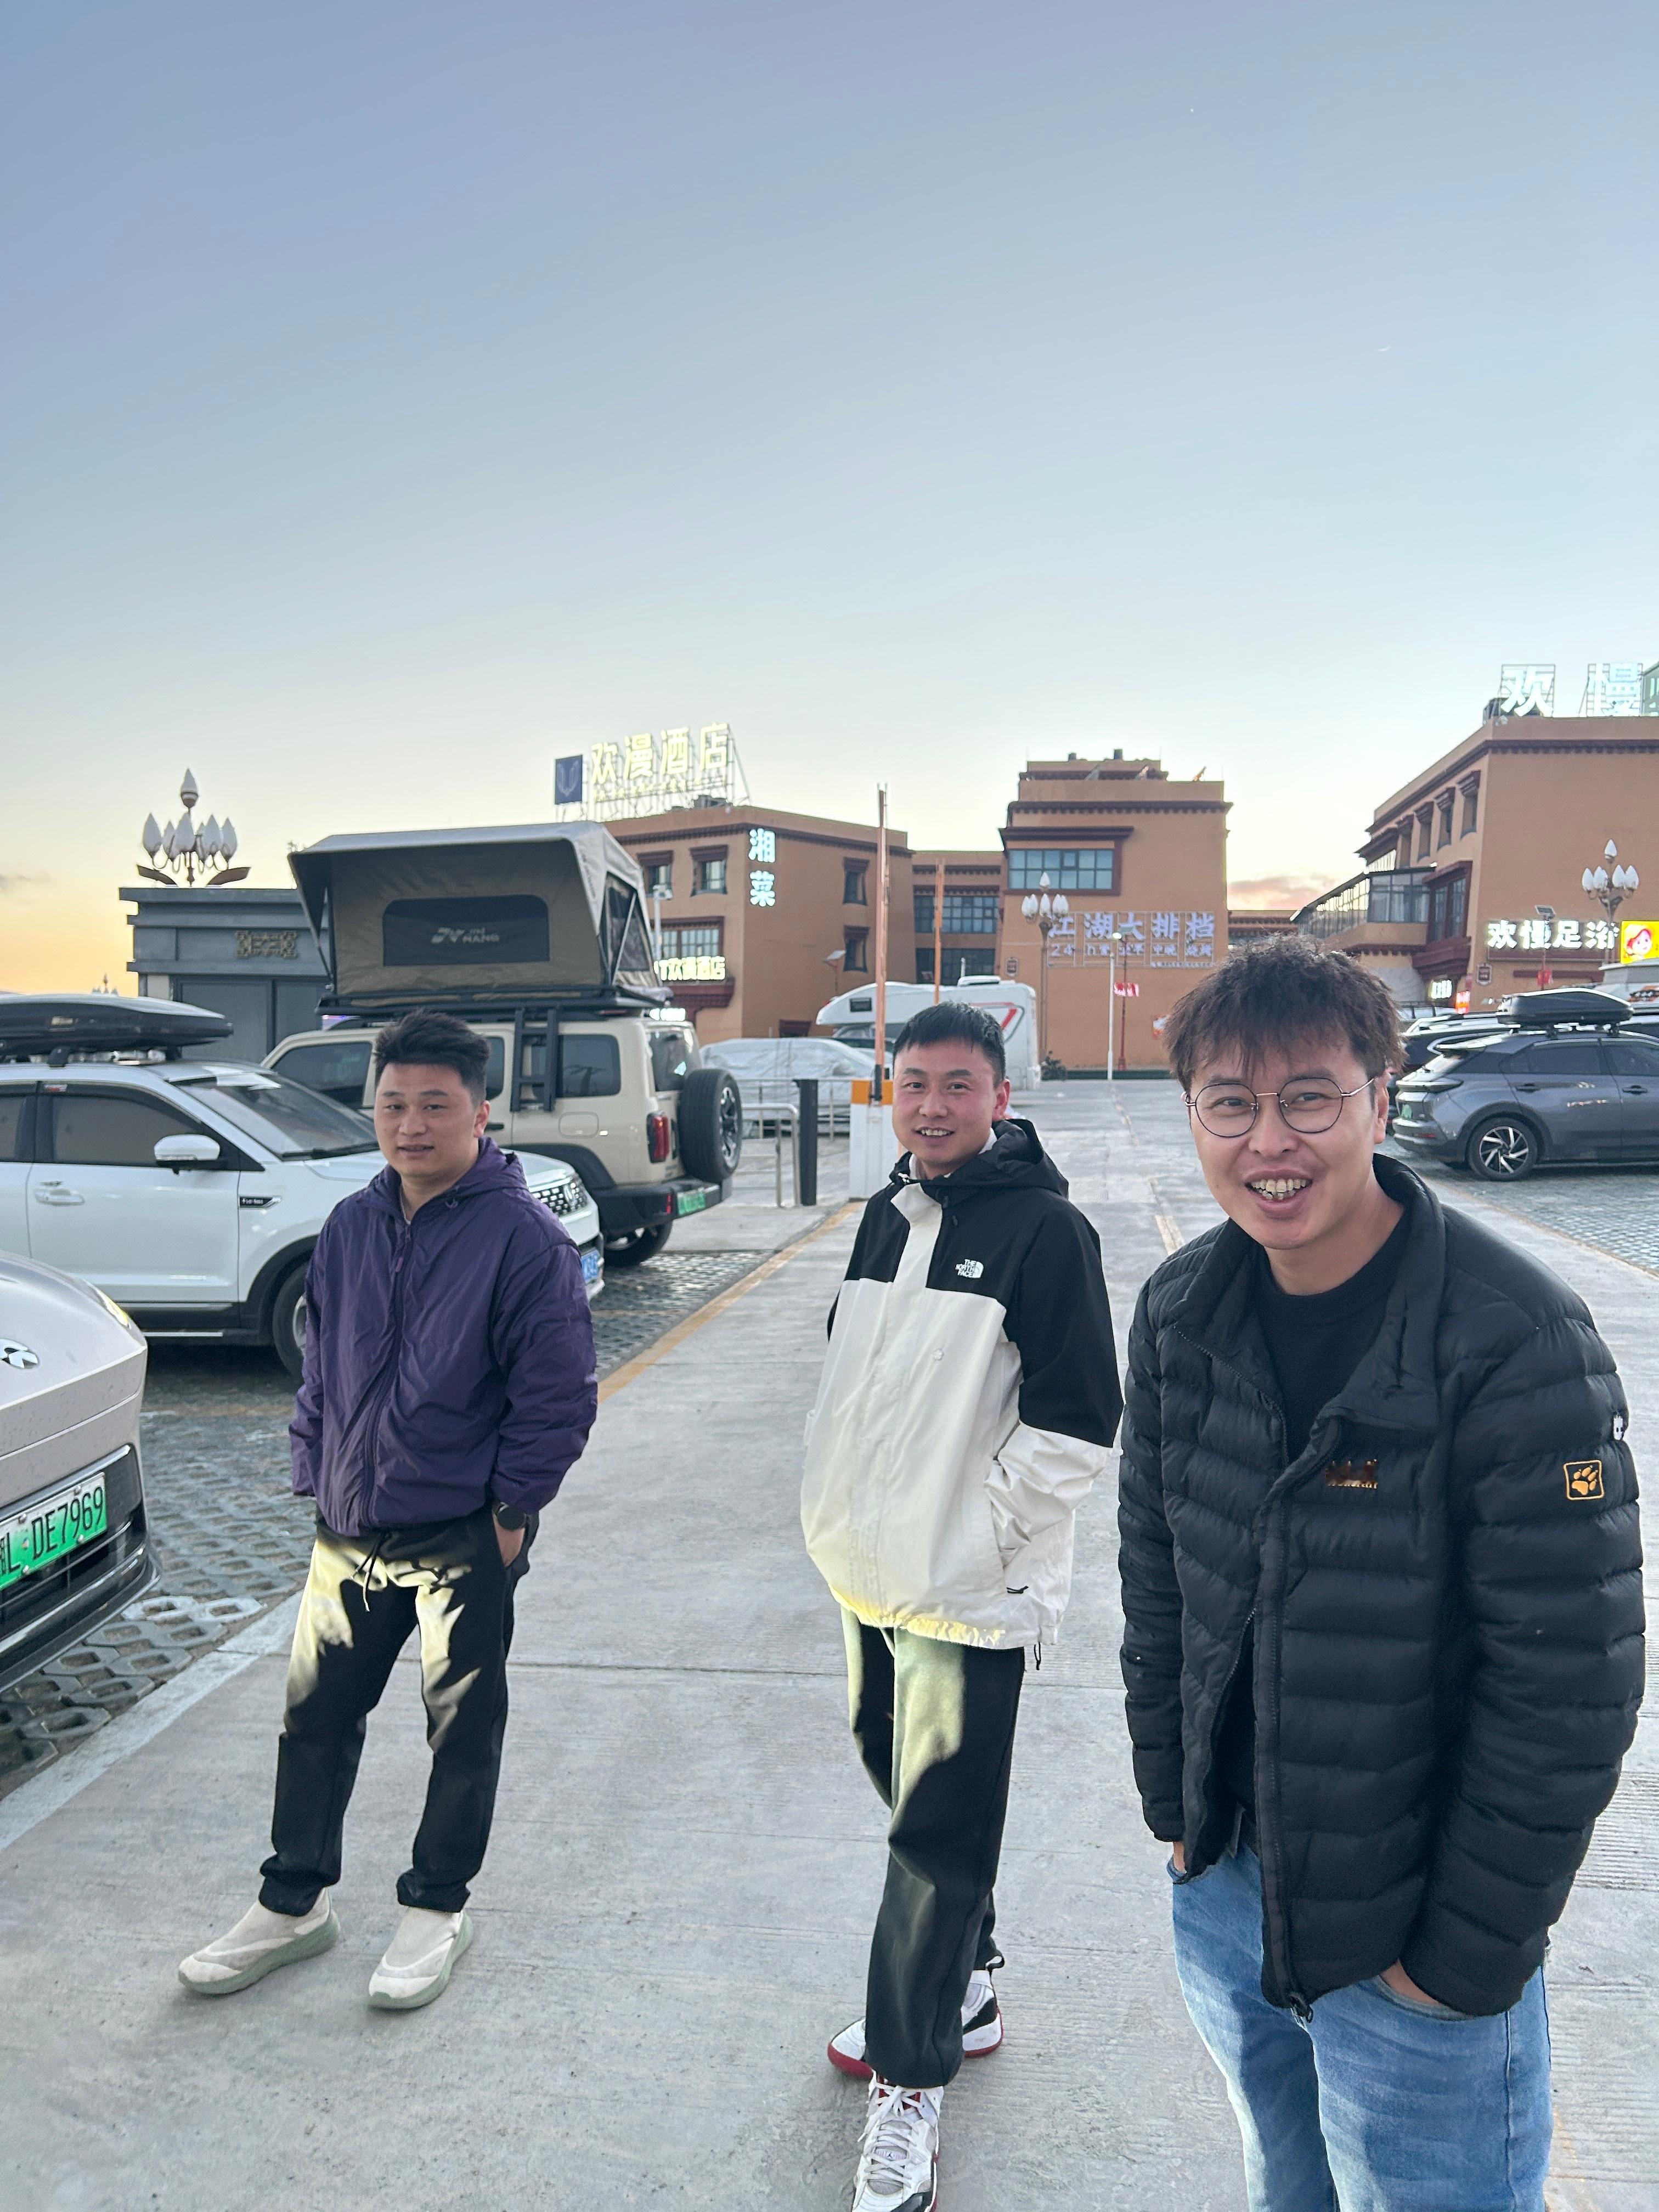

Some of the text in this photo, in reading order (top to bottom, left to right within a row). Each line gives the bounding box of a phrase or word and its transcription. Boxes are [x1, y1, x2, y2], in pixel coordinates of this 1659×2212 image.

[591, 722, 728, 785] 欢漫酒店
[748, 828, 776, 907] 湘菜
[1047, 911, 1214, 940] 江湖大排档
[31, 1486, 104, 1560] DE7969
